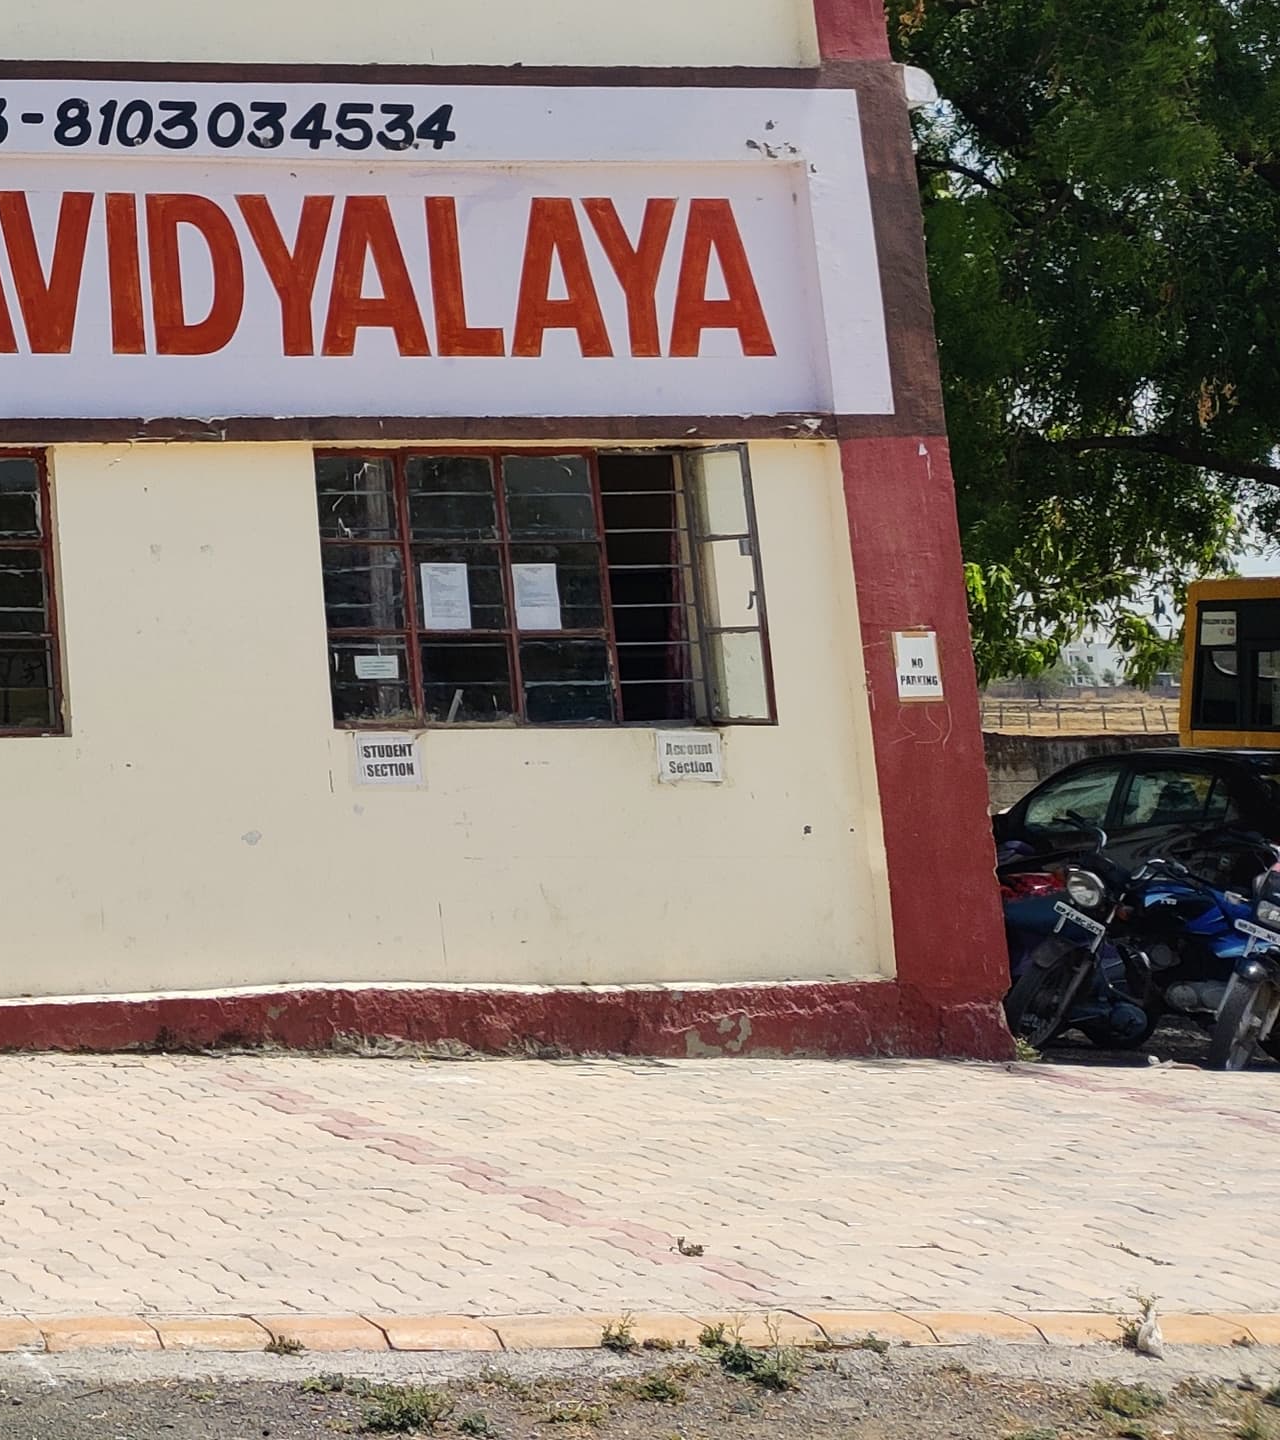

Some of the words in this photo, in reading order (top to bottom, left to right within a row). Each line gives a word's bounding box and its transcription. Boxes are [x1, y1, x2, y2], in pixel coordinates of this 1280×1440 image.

[911, 658, 924, 669] NO
[900, 675, 938, 686] PARKING
[363, 743, 413, 758] STUDENT
[366, 763, 415, 777] SECTION
[669, 760, 713, 774] Section
